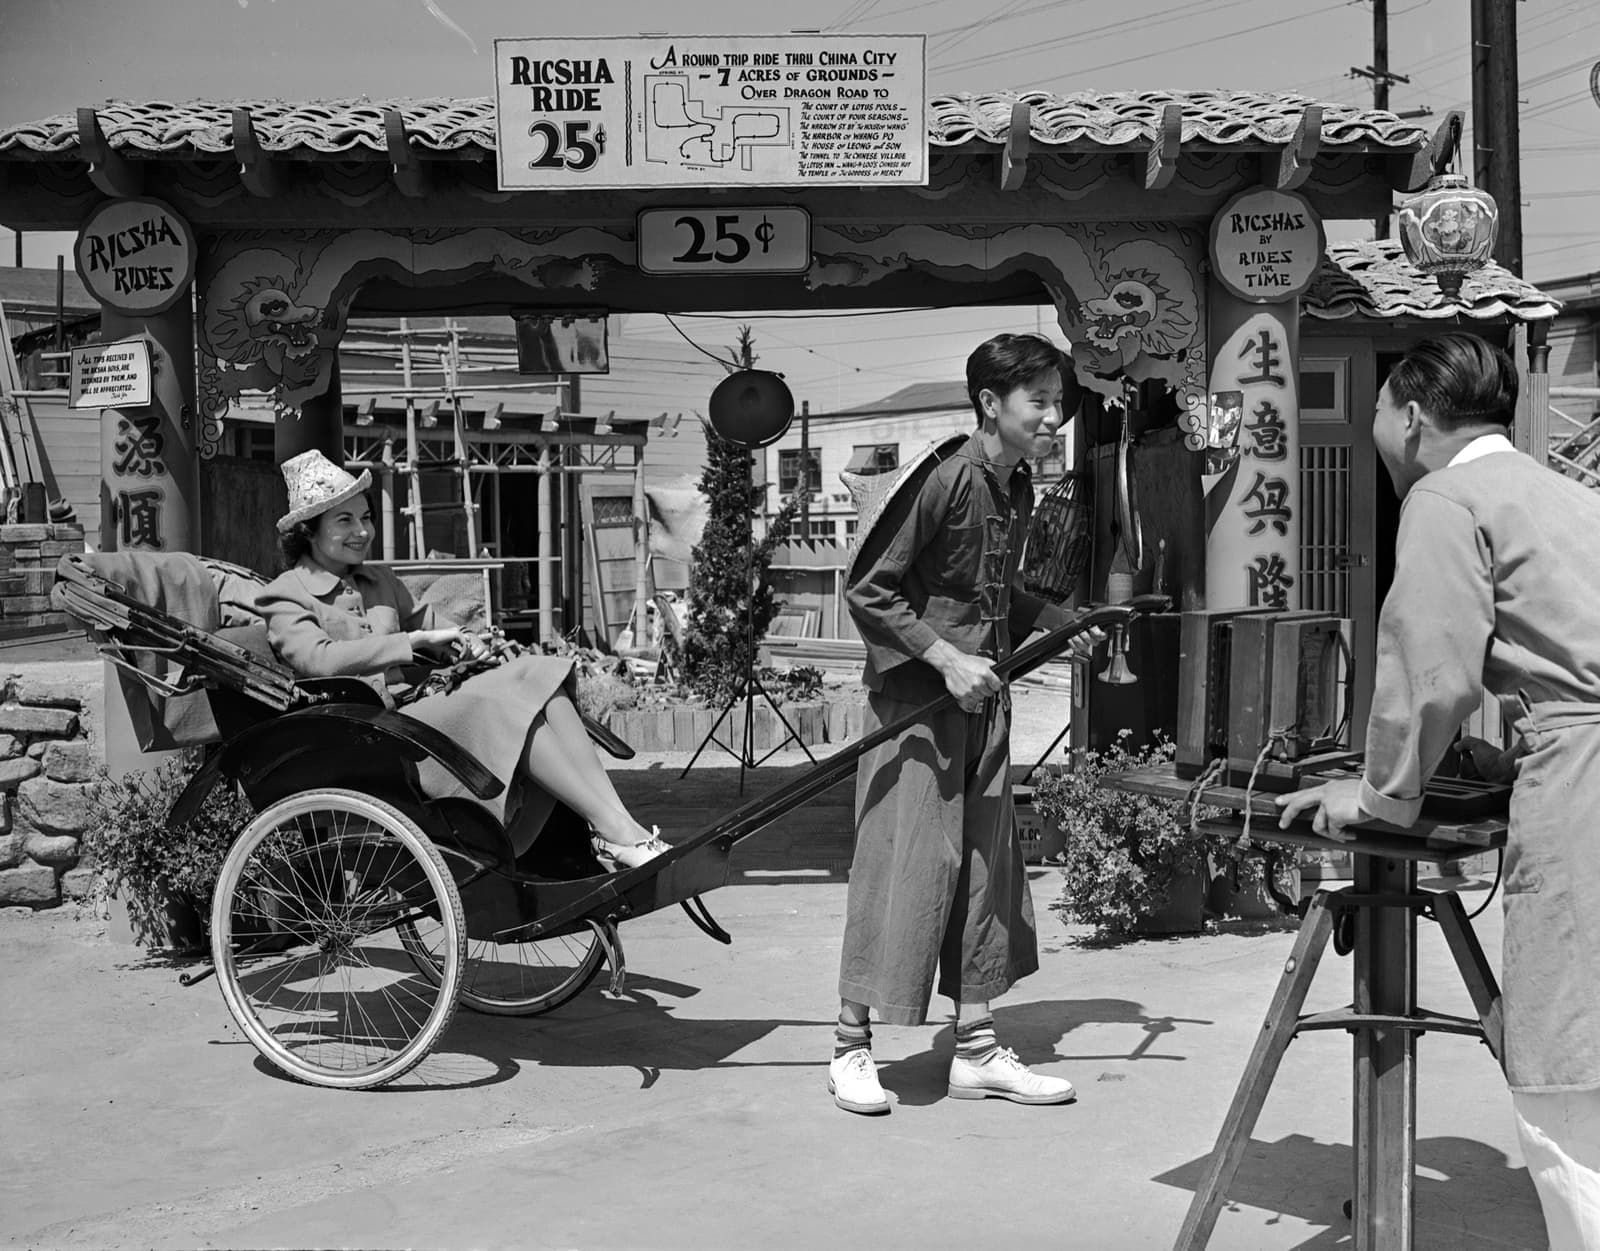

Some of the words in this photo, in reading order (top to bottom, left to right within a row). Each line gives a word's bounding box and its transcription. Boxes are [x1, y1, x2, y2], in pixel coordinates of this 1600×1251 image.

[650, 45, 677, 69] A
[682, 54, 720, 66] ROUND
[723, 53, 749, 66] TRIP
[753, 53, 779, 65] RIDE
[785, 52, 813, 65] THRU
[819, 51, 858, 65] CHINA
[863, 50, 897, 64] CITY
[510, 56, 615, 85] RICSHA
[717, 68, 731, 86] 7
[737, 69, 780, 81] ACRES
[786, 72, 801, 81] OF
[806, 69, 878, 81] GROUNDS
[530, 86, 602, 112] RIDE
[741, 85, 777, 99] OVER
[784, 87, 831, 98] DRAGON
[836, 87, 869, 98] ROAD
[873, 88, 889, 98] TO
[815, 103, 838, 111] COURT
[839, 103, 849, 111] OF
[852, 103, 874, 111] LOTUS
[875, 103, 898, 111] POOLS
[813, 113, 835, 121] COURT
[836, 113, 846, 121] OF
[848, 113, 866, 121] FOUR
[867, 113, 902, 121] SEASONS
[882, 132, 894, 141] PO
[528, 120, 608, 172] 25¢
[811, 142, 835, 150] HOUSE
[847, 142, 871, 150] LEONG
[886, 142, 902, 150] SON
[1230, 211, 1306, 234] RICSHAS
[86, 215, 182, 274] RICSHA
[672, 213, 775, 264] 25¢
[1259, 234, 1273, 244] BY
[1239, 250, 1293, 266] RIDES
[112, 265, 175, 296] RIDES
[1244, 273, 1291, 287] TIME
[77, 353, 91, 365] ALL
[93, 355, 105, 363] TIPS
[80, 387, 92, 395] WILL
